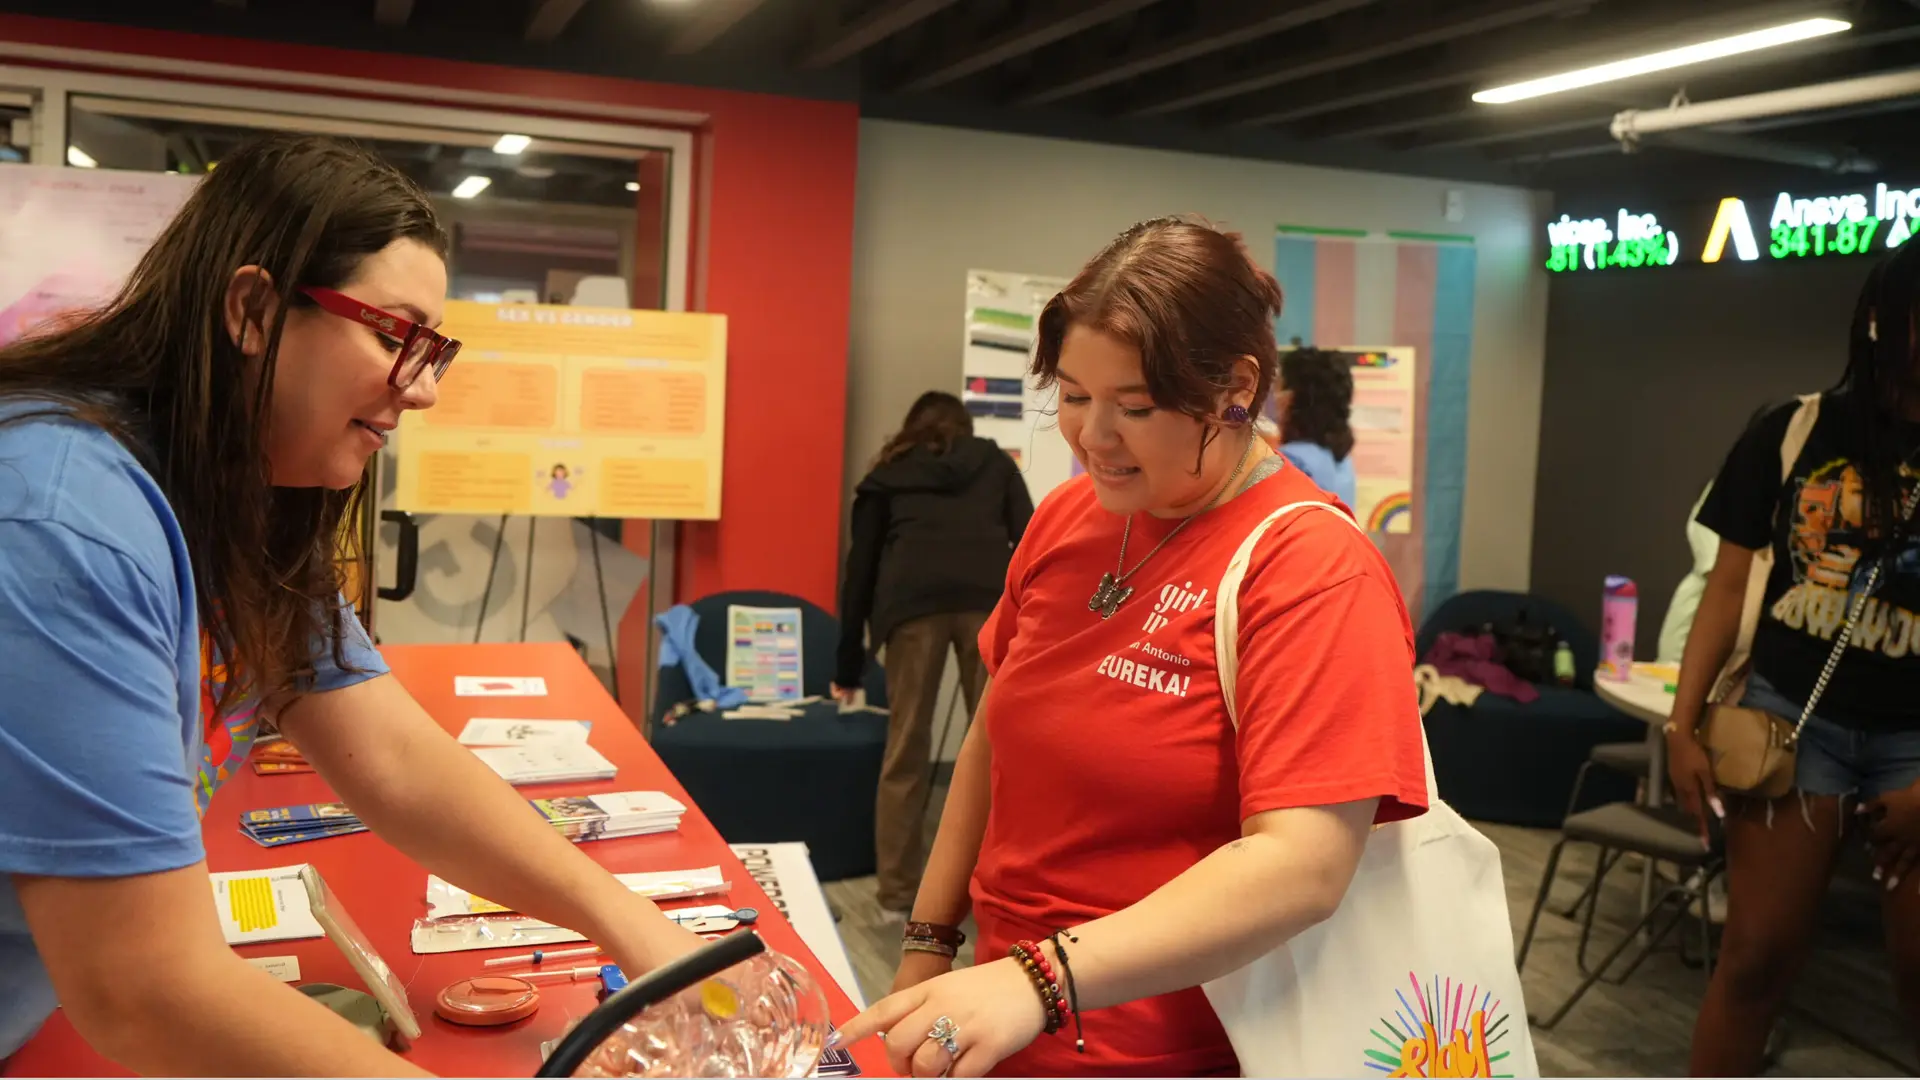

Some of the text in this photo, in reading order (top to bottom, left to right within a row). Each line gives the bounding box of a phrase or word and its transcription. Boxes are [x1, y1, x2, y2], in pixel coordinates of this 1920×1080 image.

[1770, 192, 1867, 229] Ansys
[1770, 216, 1880, 258] 341.87
[1154, 581, 1208, 613] girl
[1142, 641, 1190, 666] Antonio
[1096, 655, 1191, 697] EUREKA!
